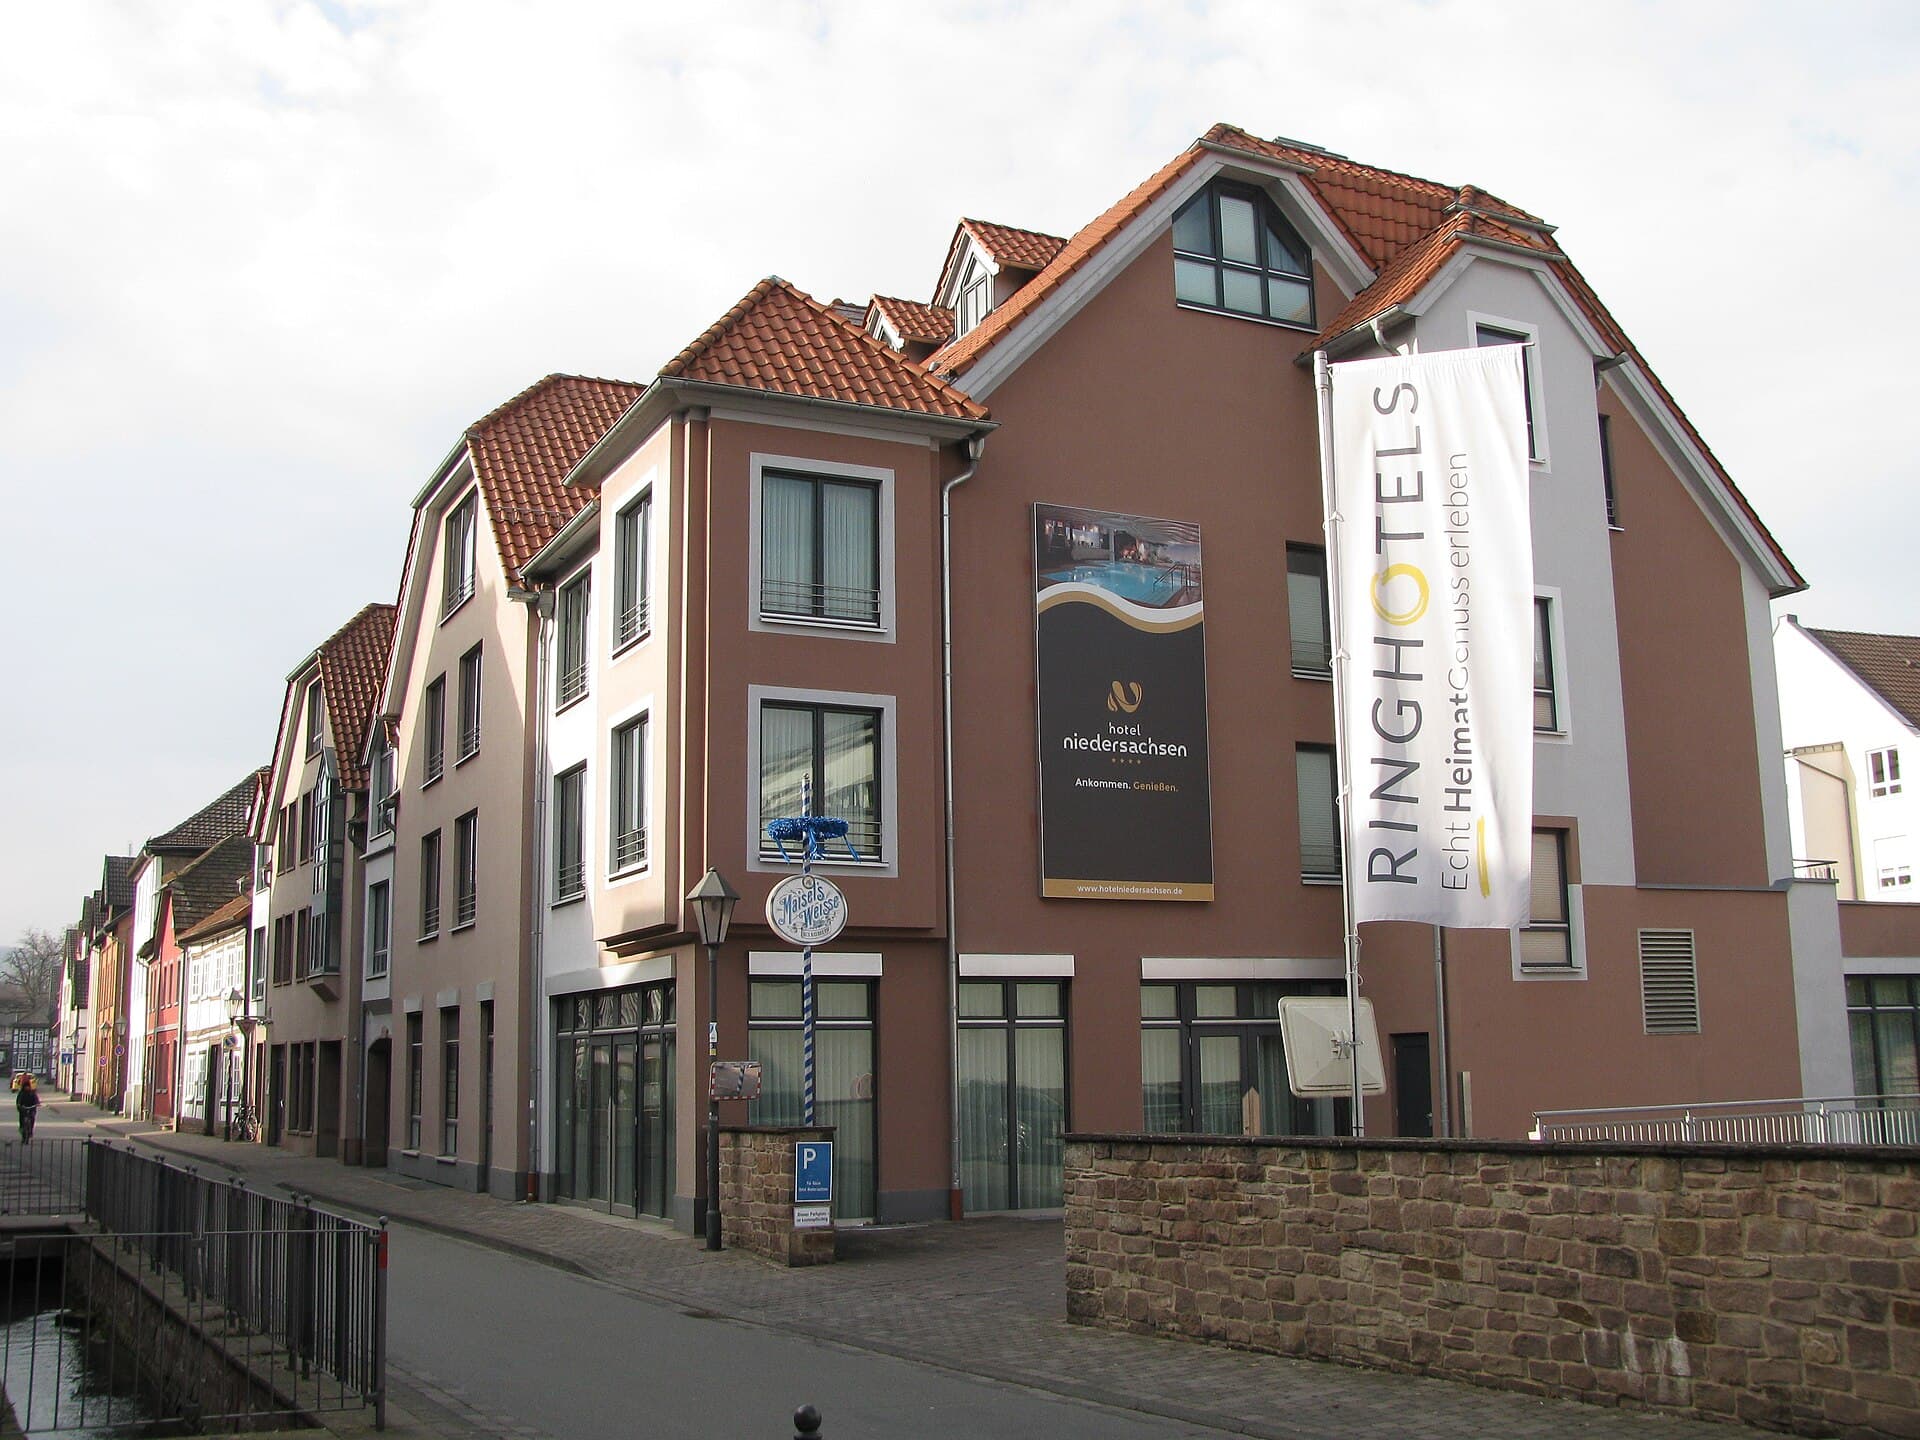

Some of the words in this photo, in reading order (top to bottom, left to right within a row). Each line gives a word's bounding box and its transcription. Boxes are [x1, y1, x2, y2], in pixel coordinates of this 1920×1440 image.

[1442, 453, 1470, 568] erleben
[1367, 382, 1430, 884] RINGHOTELS
[1108, 721, 1141, 736] hotel
[1063, 732, 1188, 757] niedersachsen
[1075, 777, 1132, 790] Ankommen.
[1133, 781, 1179, 792] Genießen.
[1441, 821, 1471, 890] Echt
[778, 880, 824, 926] Maisel's
[1077, 884, 1183, 896] www.hotelniedersachsen.de
[799, 895, 840, 928] Weisse
[803, 1147, 817, 1170] P
